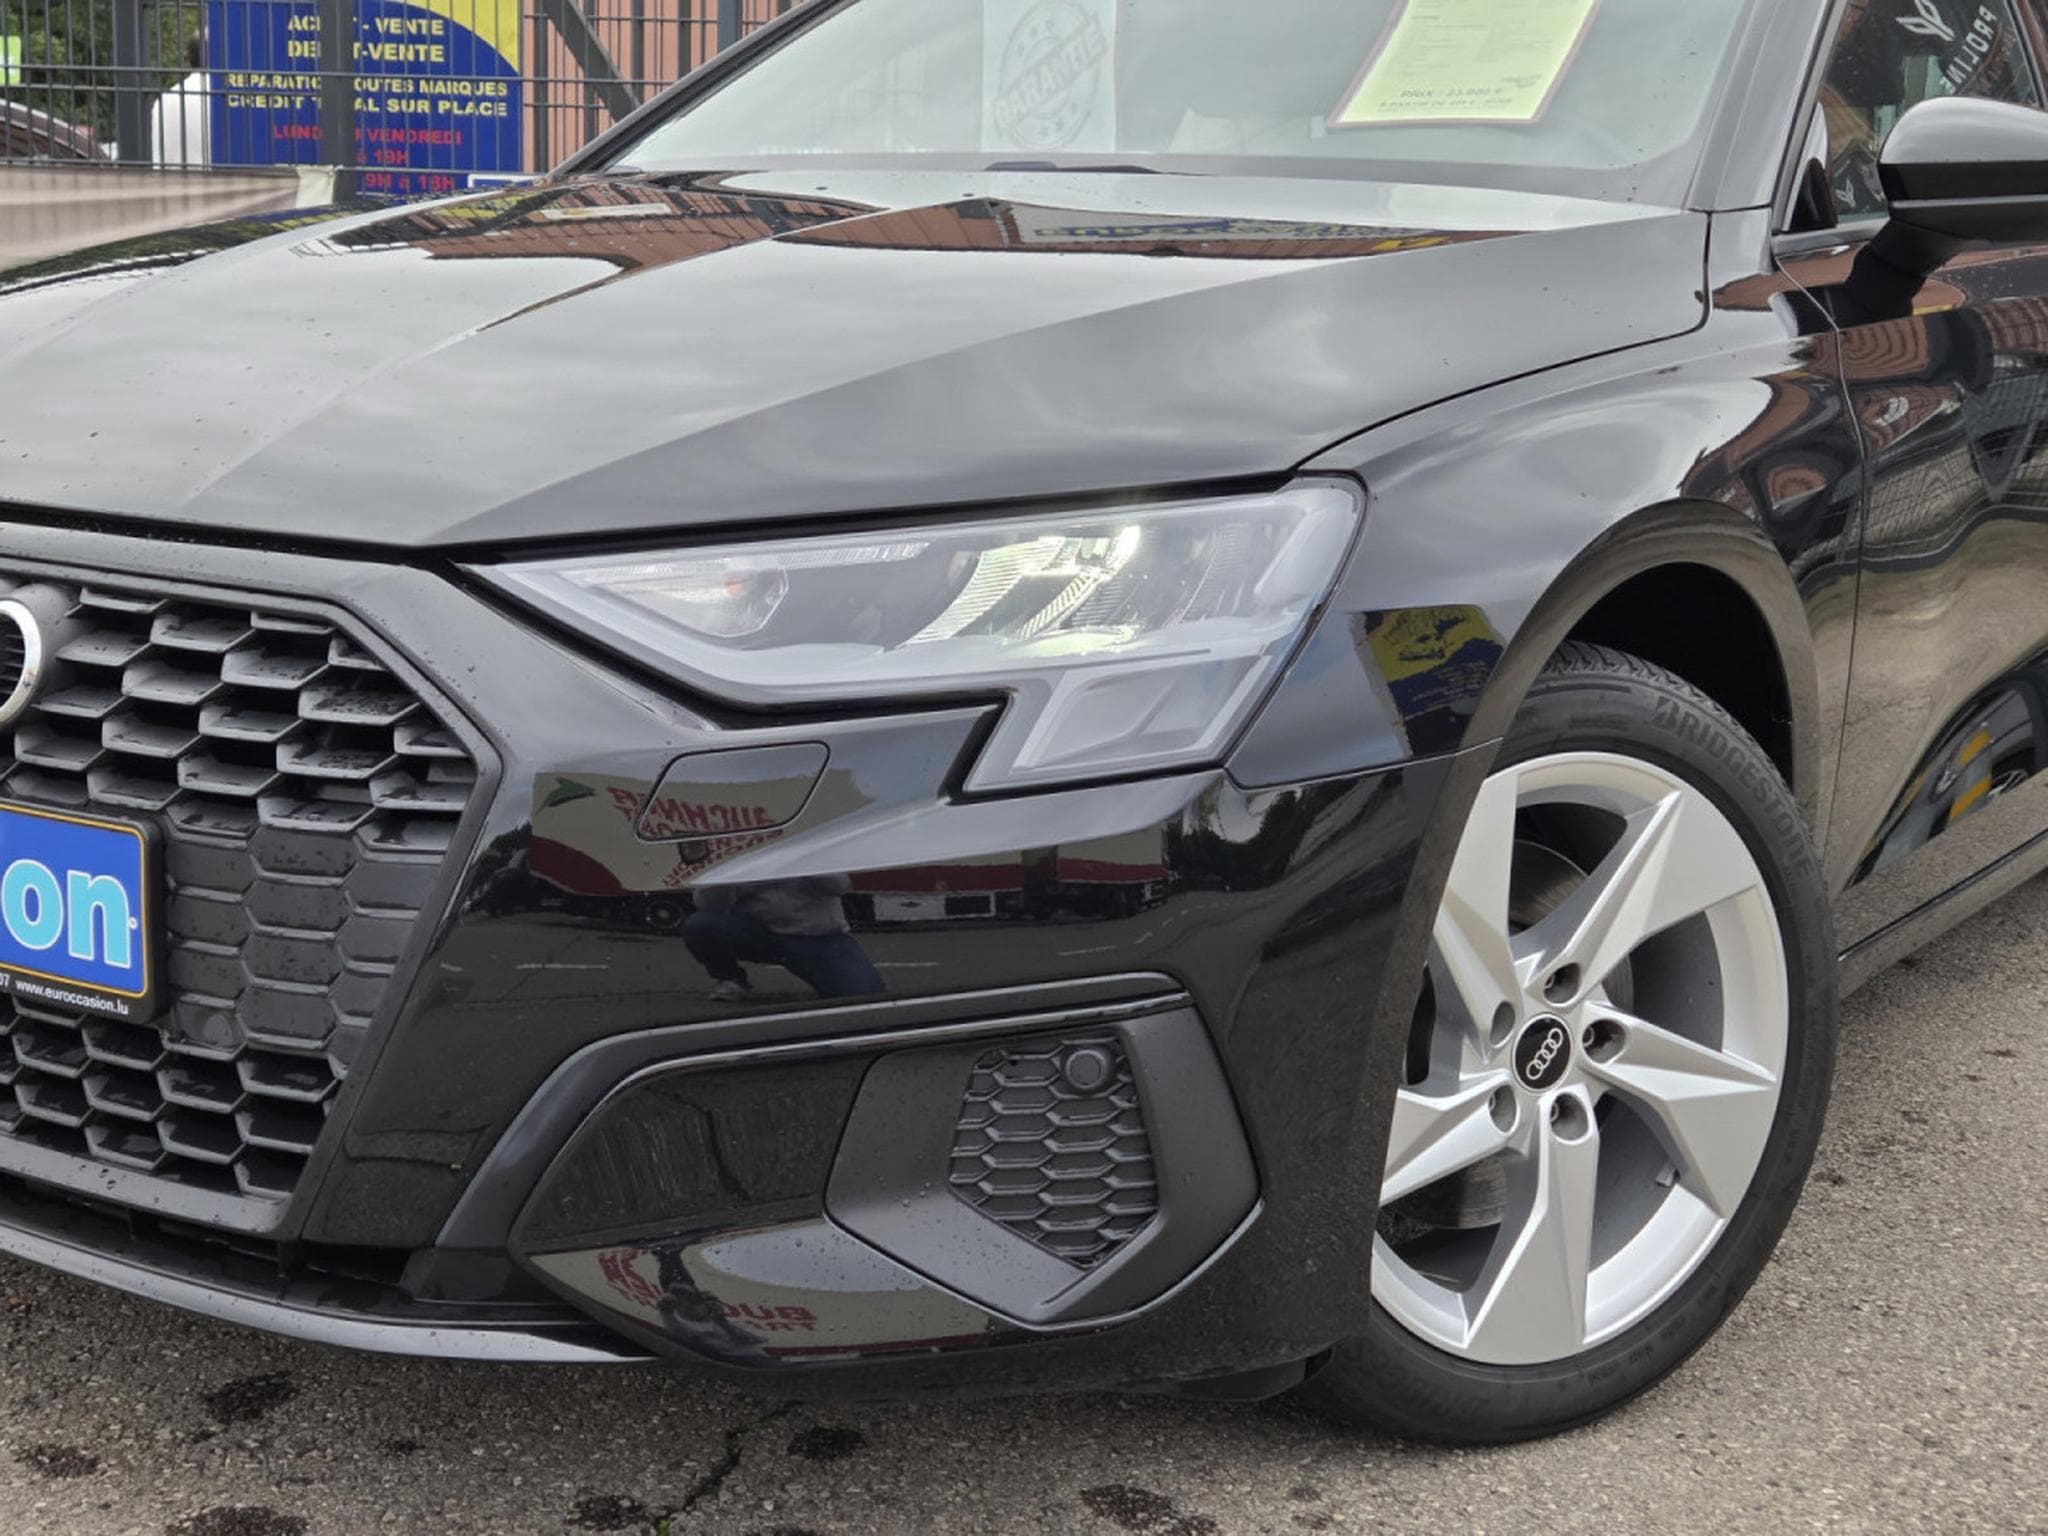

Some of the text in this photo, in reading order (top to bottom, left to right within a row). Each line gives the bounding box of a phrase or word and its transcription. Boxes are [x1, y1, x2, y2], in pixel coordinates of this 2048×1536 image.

[374, 17, 444, 35] VENTE
[353, 77, 415, 93] OUTES
[418, 79, 508, 97] MARQUES
[227, 94, 305, 109] CREDIT
[386, 98, 430, 114] SUR
[438, 100, 508, 116] PLACE
[273, 124, 322, 141] LUND
[366, 128, 463, 145] VENDREDI
[1651, 695, 1813, 879] BRIDGESTONE
[1, 859, 131, 969] on
[15, 979, 130, 1015] www.euroccasion.lu
